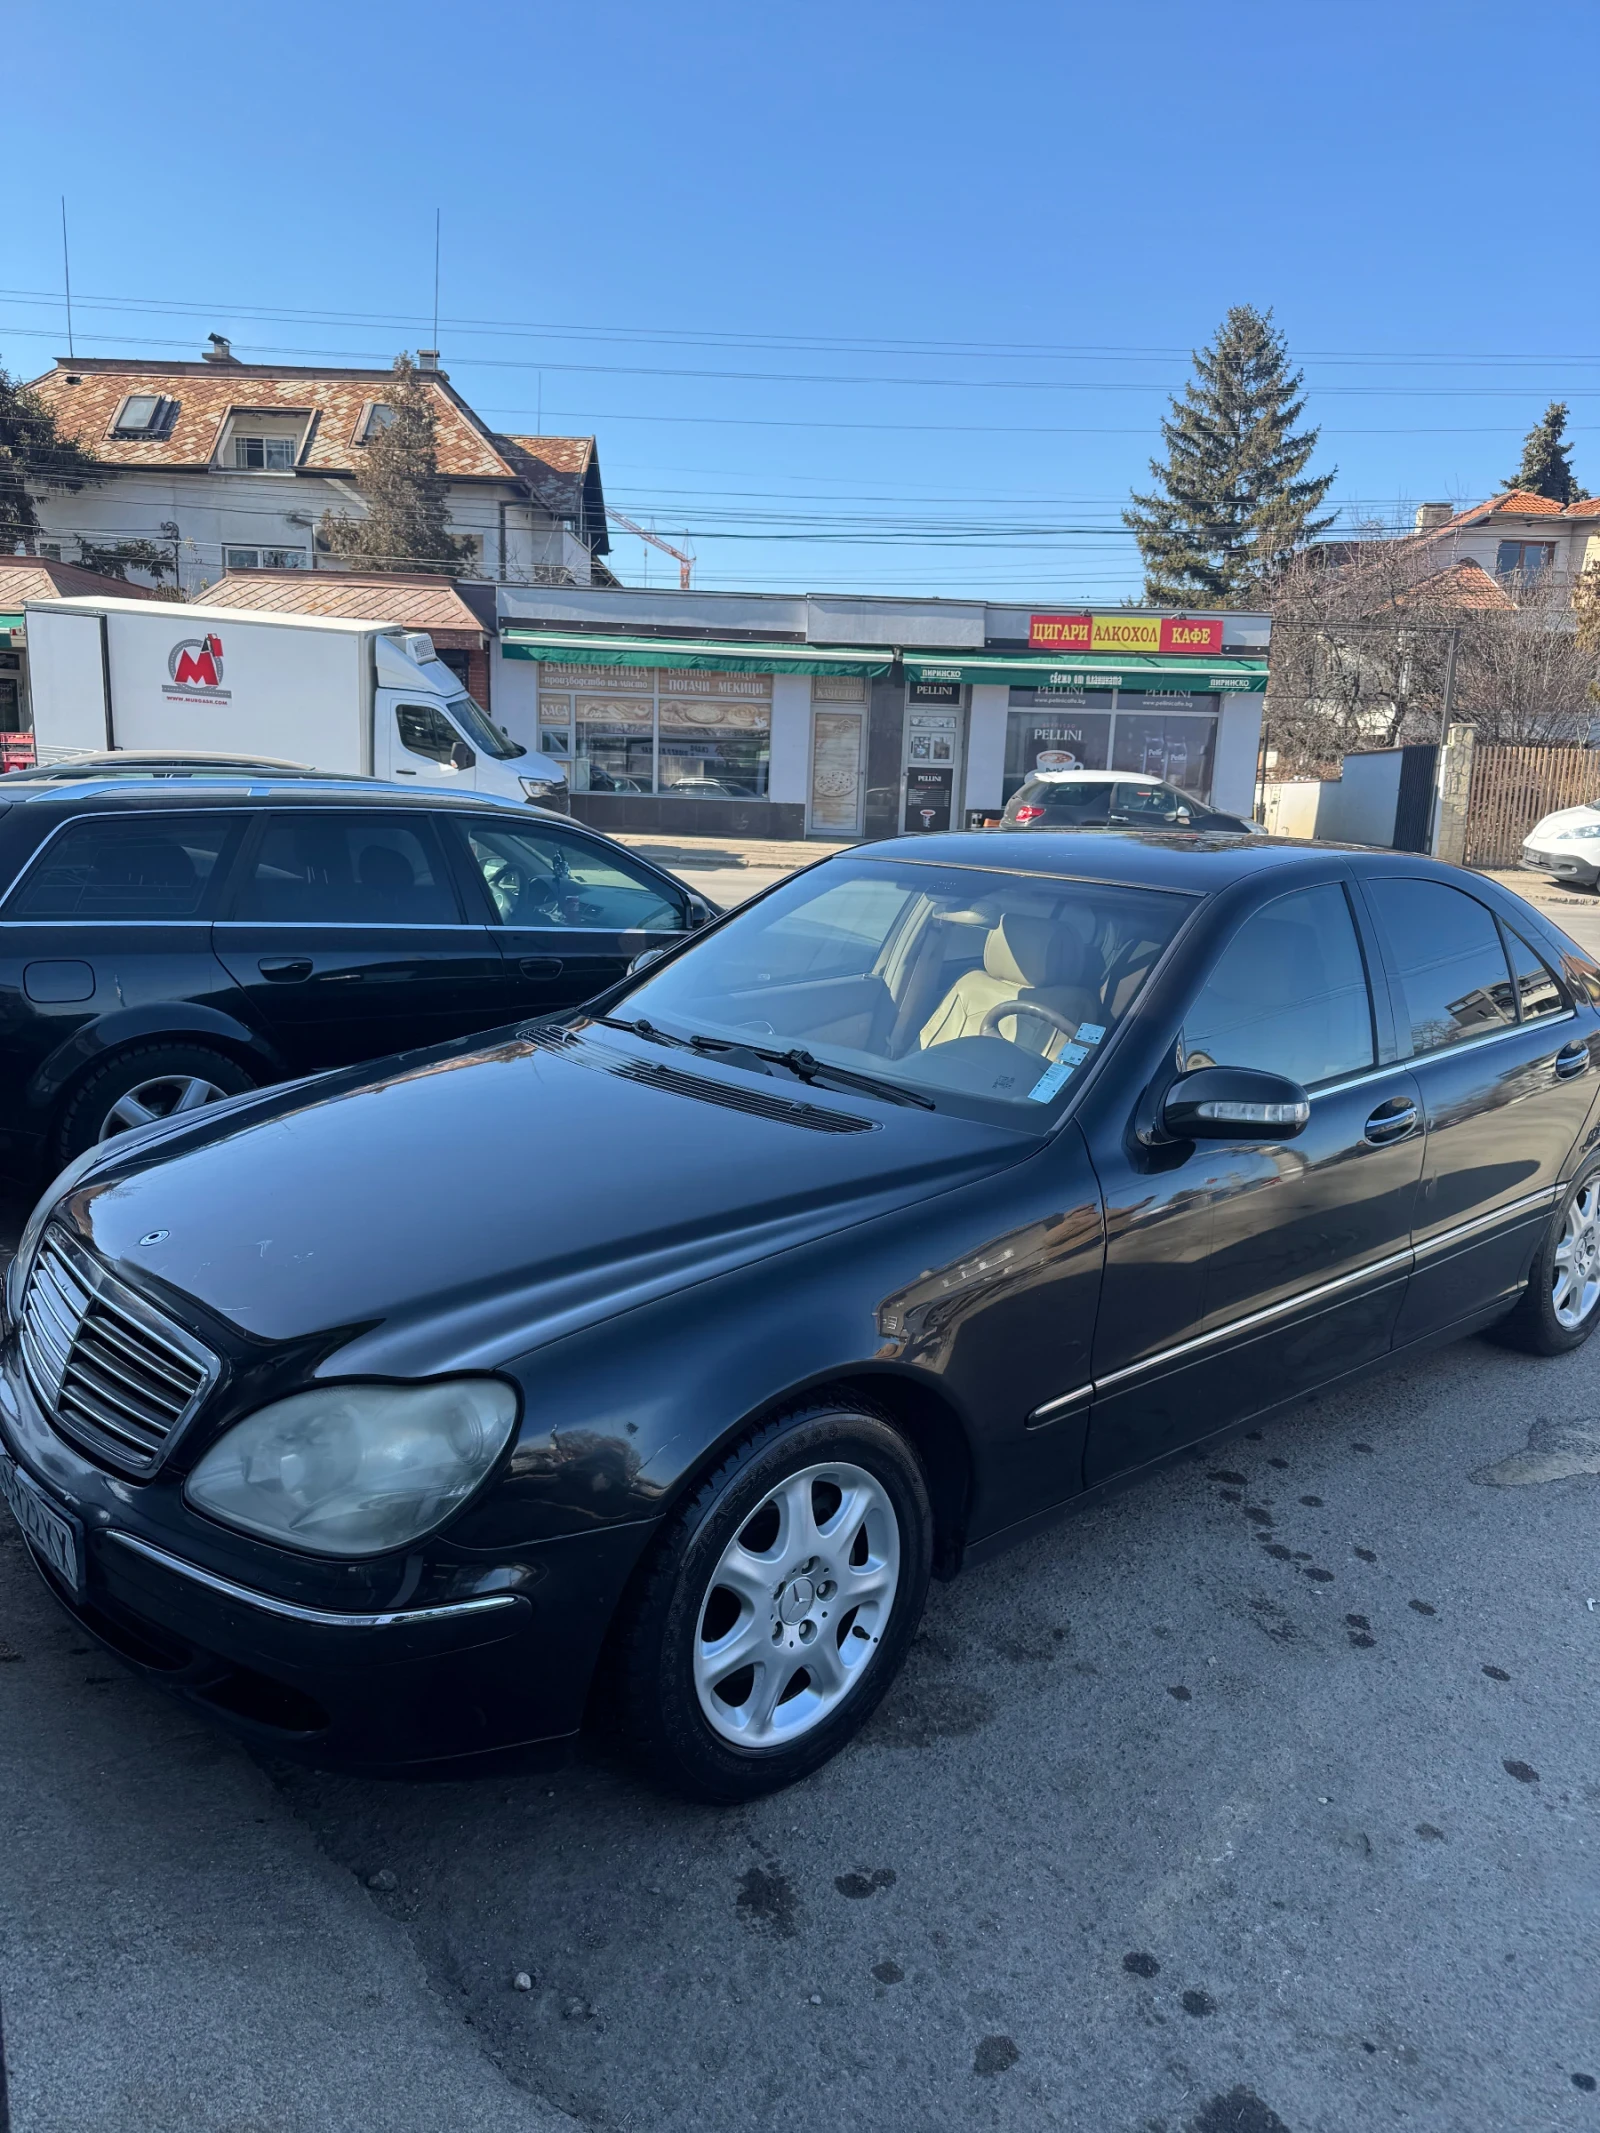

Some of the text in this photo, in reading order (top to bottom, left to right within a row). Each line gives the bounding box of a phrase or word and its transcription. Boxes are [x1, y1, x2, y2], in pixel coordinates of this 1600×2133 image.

[1032, 623, 1089, 642] ЦИГАРИ
[1093, 625, 1158, 643] АЛКОХОЛ
[1171, 627, 1211, 644] КАФЕ
[544, 661, 649, 679] БАНИЧАРНИЦА
[922, 669, 961, 678] ПИРИНСКО
[544, 676, 606, 687] производство
[607, 679, 618, 687] на
[669, 679, 764, 696] ПОГАЧИ МЕКИЦИ
[1210, 679, 1250, 687] ПИРИНСКО
[916, 685, 953, 695] PELLINI
[1037, 685, 1085, 696] PELLINI
[1144, 688, 1192, 699] PELLINI
[541, 704, 569, 717] КАСА
[1034, 728, 1083, 741] PELLINI
